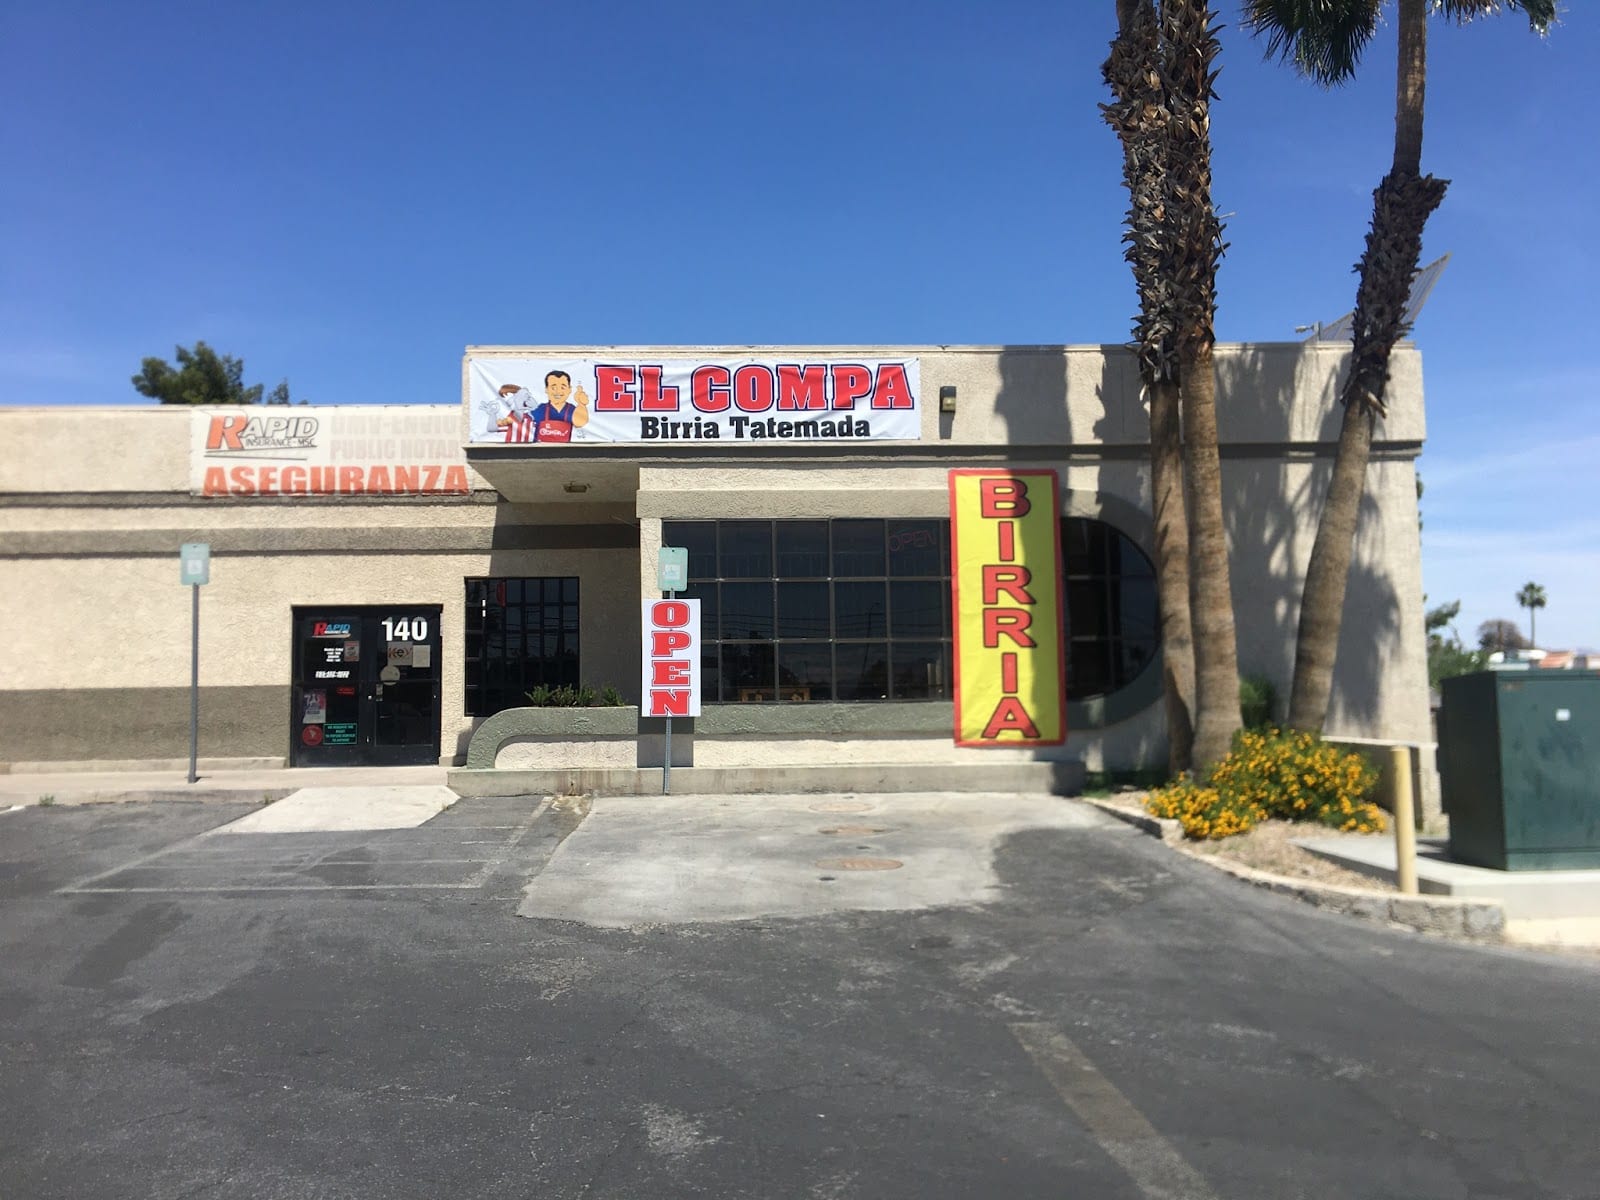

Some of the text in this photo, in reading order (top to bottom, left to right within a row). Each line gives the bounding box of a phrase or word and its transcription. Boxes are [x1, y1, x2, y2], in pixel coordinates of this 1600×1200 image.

[594, 364, 915, 412] EL COMPA
[206, 410, 319, 449] RAPID
[641, 415, 870, 439] Birria Tatemada
[330, 440, 395, 460] PUBLIC
[203, 465, 469, 497] ASEGURANZA
[980, 478, 1041, 739] BIRRIA
[313, 621, 351, 636] RAPID
[381, 617, 428, 641] 140
[650, 601, 691, 717] OPEN
